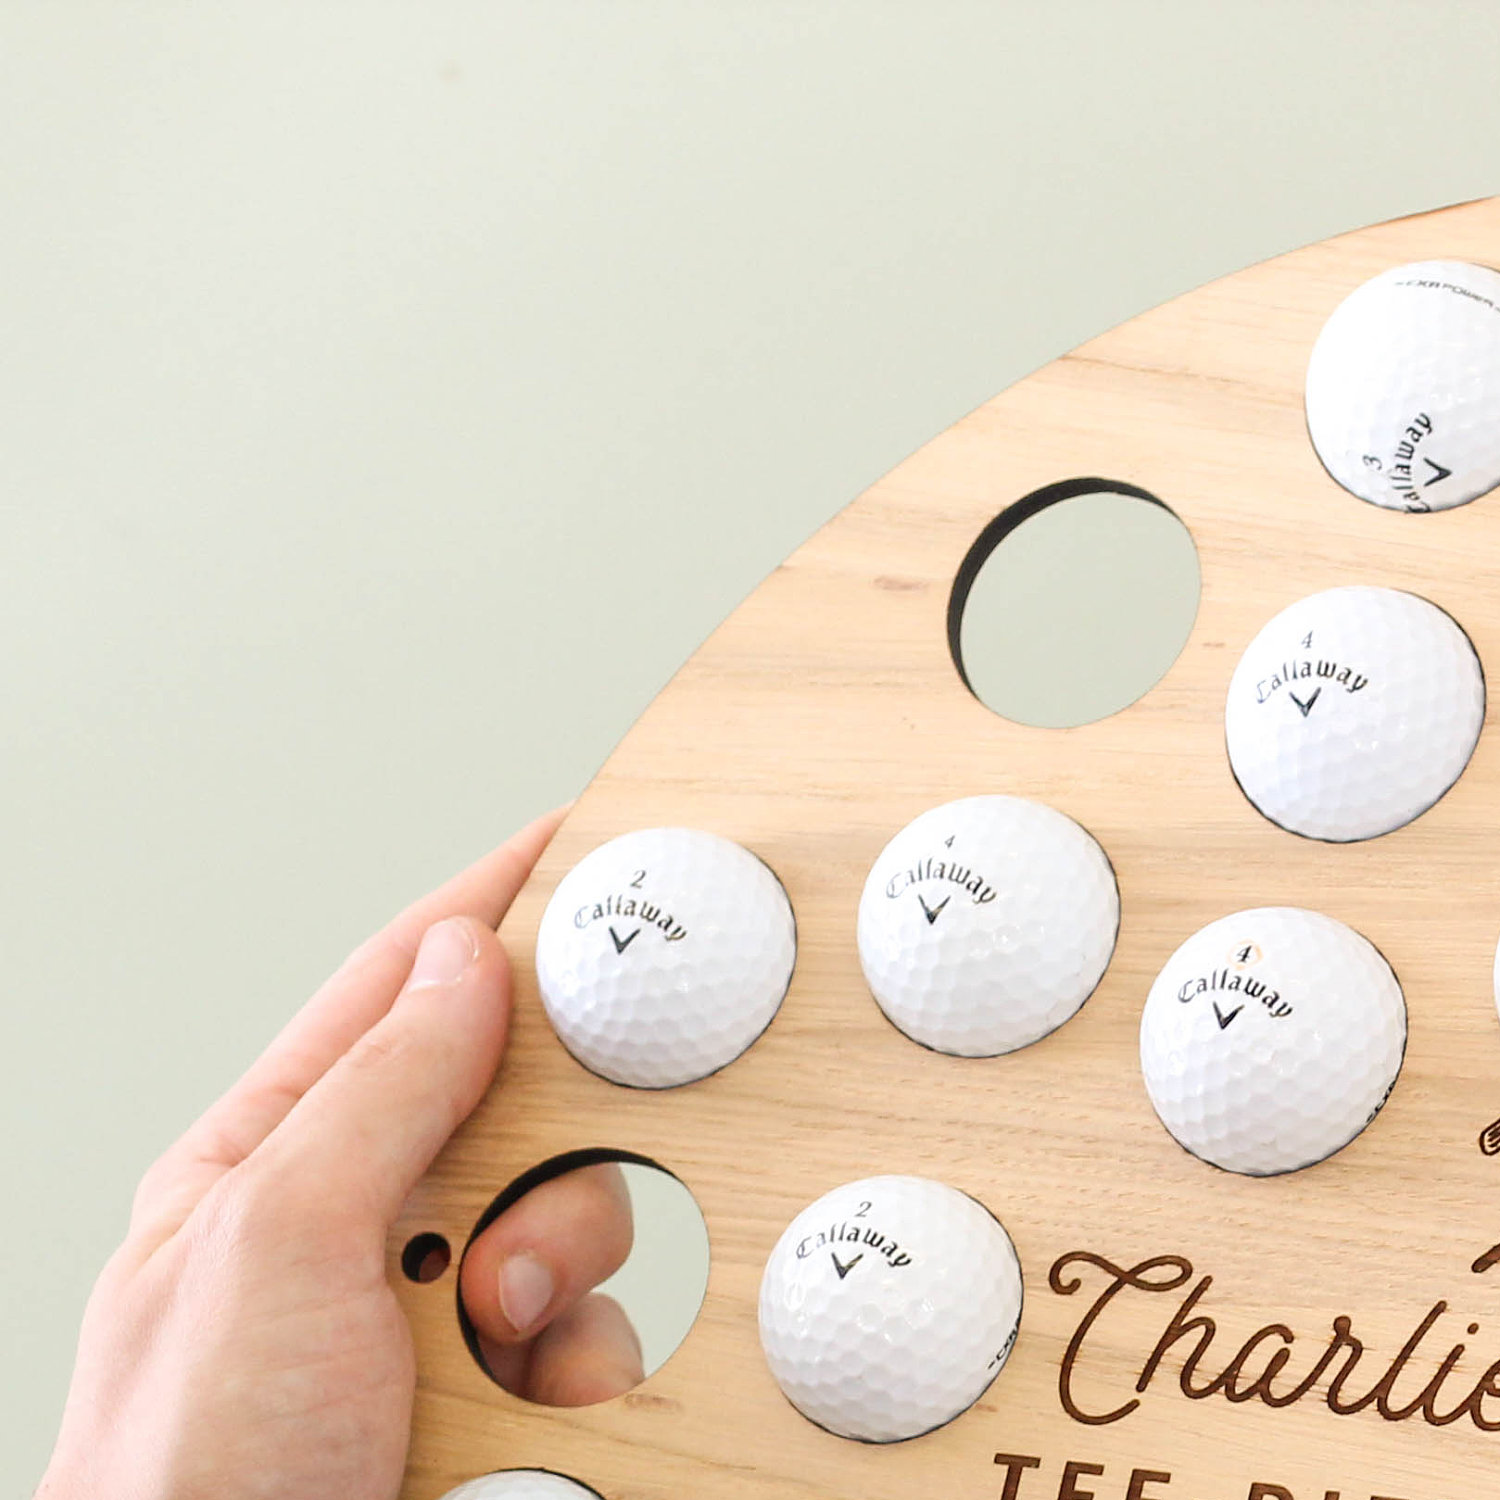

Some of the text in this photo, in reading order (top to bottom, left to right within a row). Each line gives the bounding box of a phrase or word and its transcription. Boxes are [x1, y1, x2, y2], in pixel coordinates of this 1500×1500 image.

[1361, 454, 1383, 472] 3
[1389, 411, 1433, 515] Callaway
[1257, 658, 1369, 704] Callaway
[629, 869, 647, 890] 2
[885, 857, 998, 910] Callaway
[574, 894, 688, 949] Callaway
[1237, 945, 1252, 966] 4
[1177, 966, 1294, 1024] Callaway
[854, 1201, 873, 1218] 2
[795, 1221, 913, 1273] Callaway
